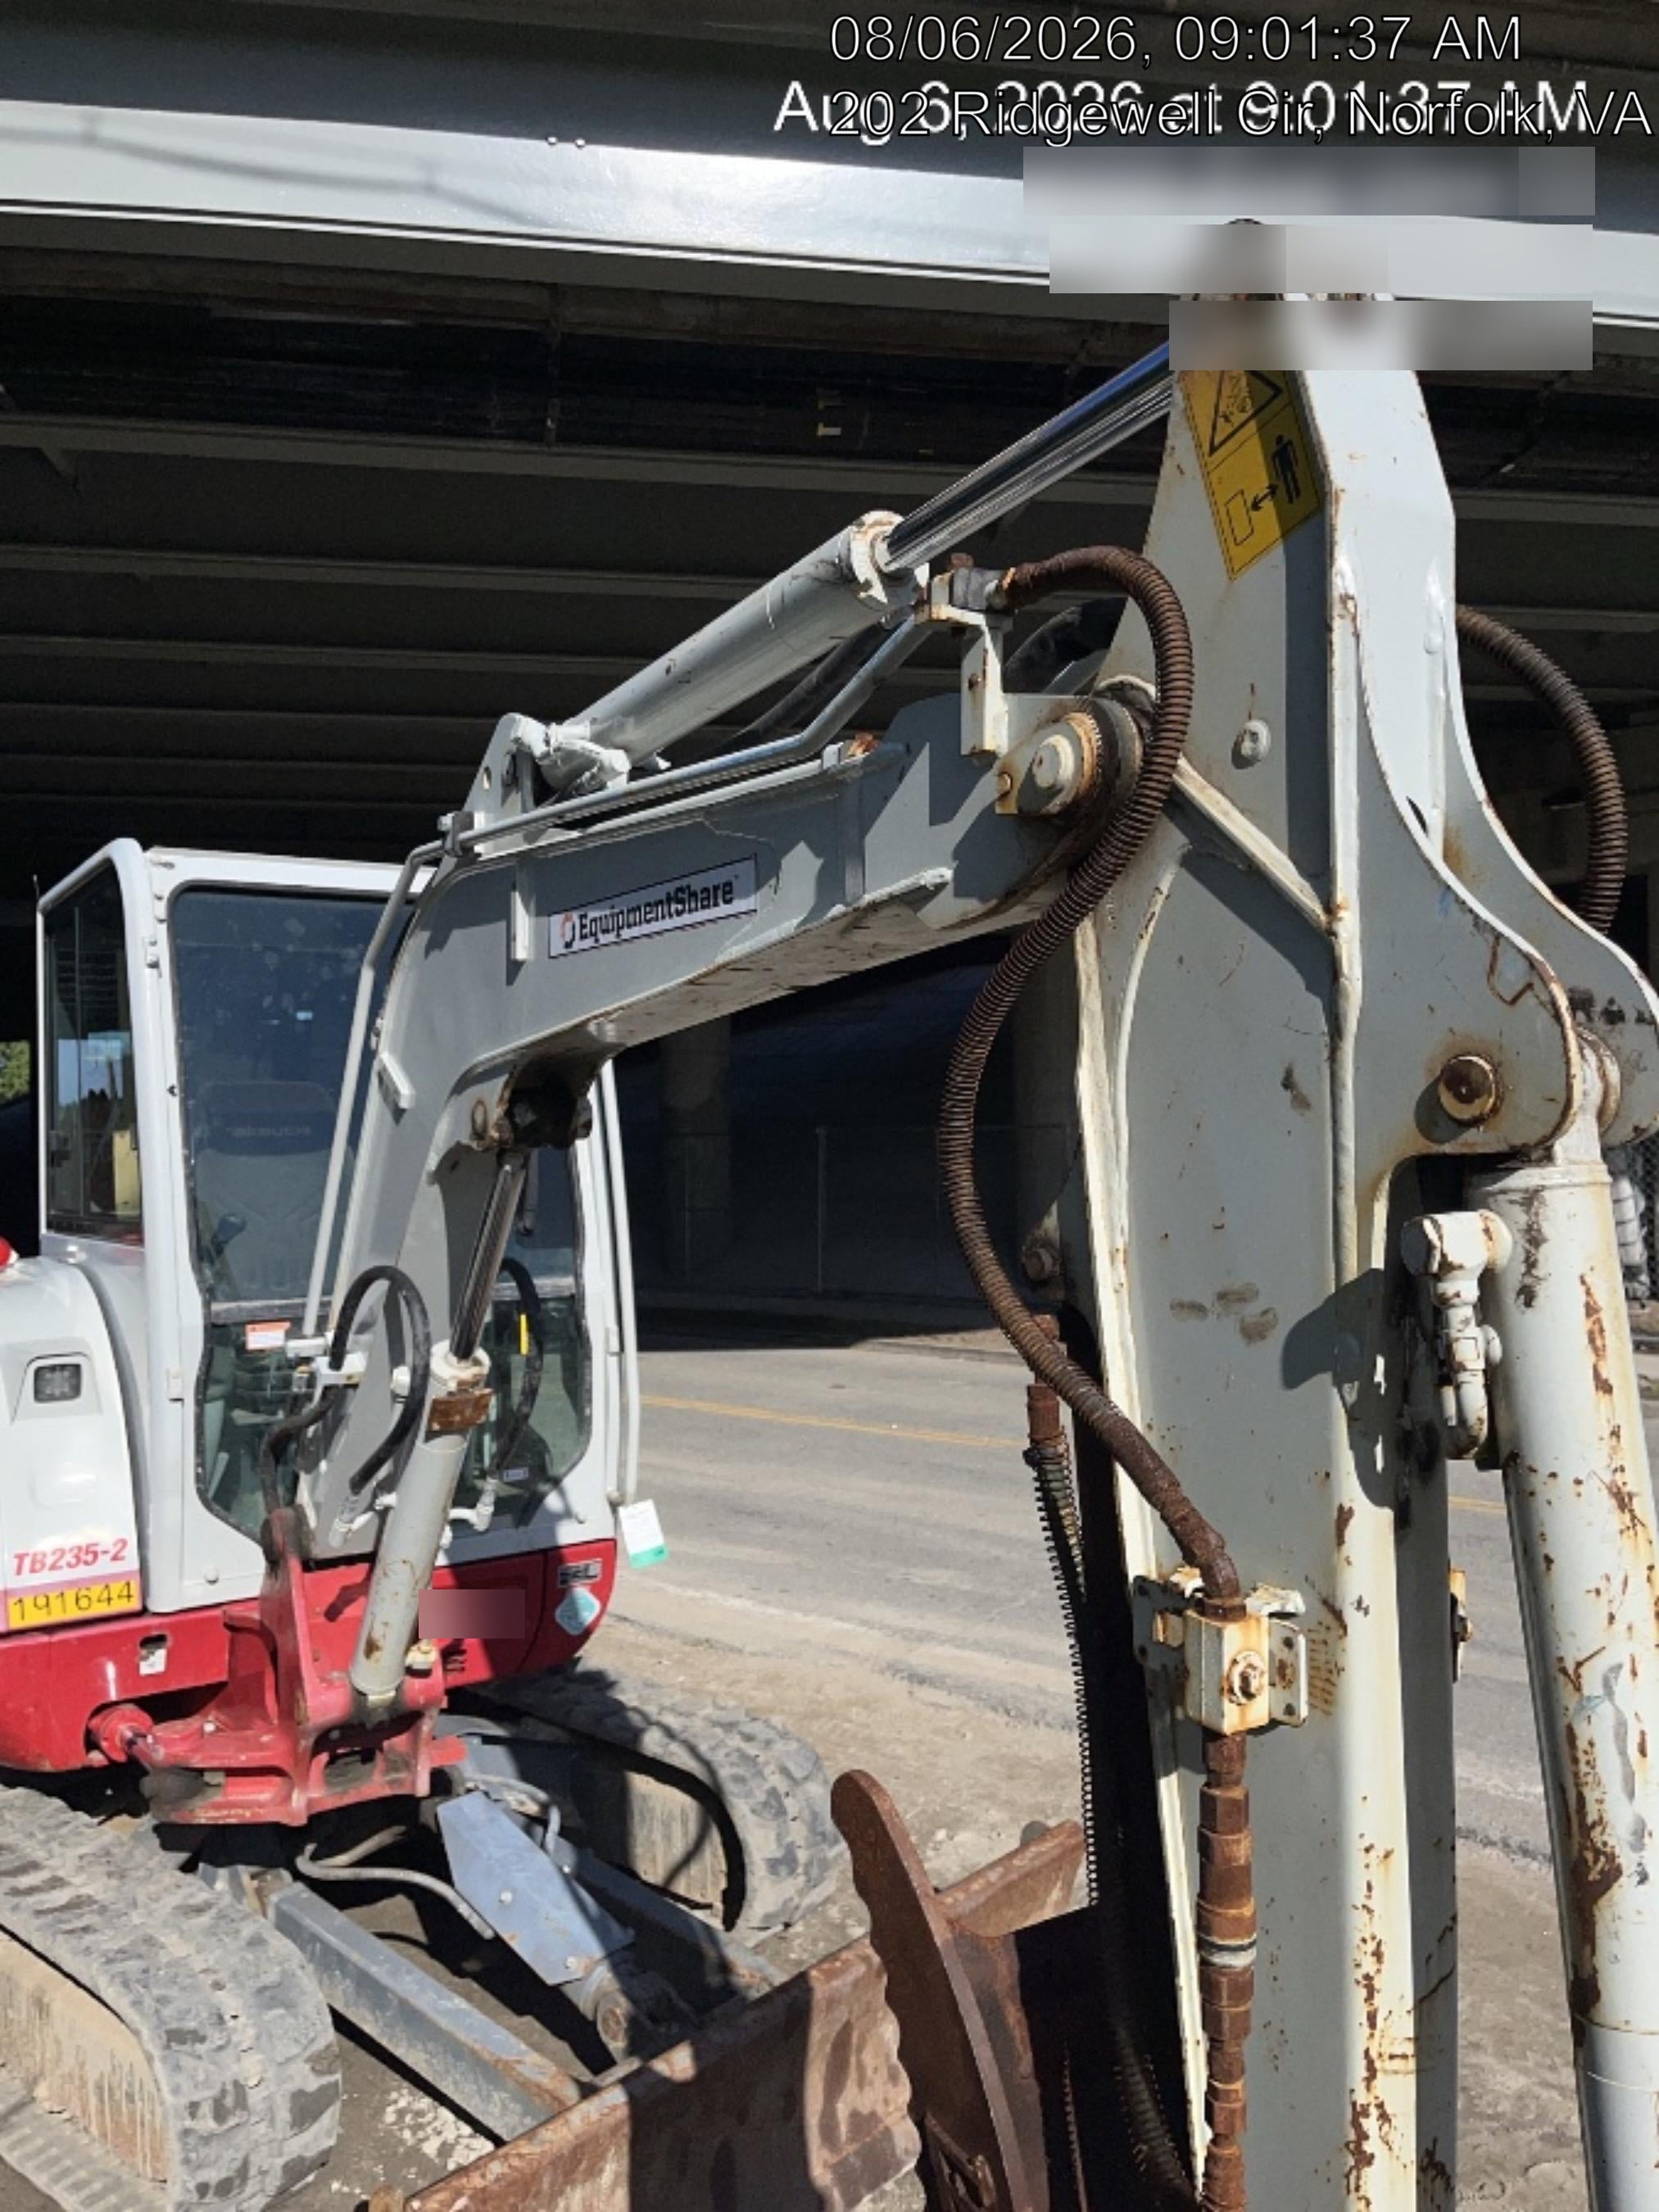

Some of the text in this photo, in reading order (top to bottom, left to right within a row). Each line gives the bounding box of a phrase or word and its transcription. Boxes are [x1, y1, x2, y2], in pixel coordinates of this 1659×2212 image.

[578, 880, 734, 943] EquipmentShare
[13, 1538, 129, 1576] TB235-2
[13, 1580, 134, 1621] 191644
